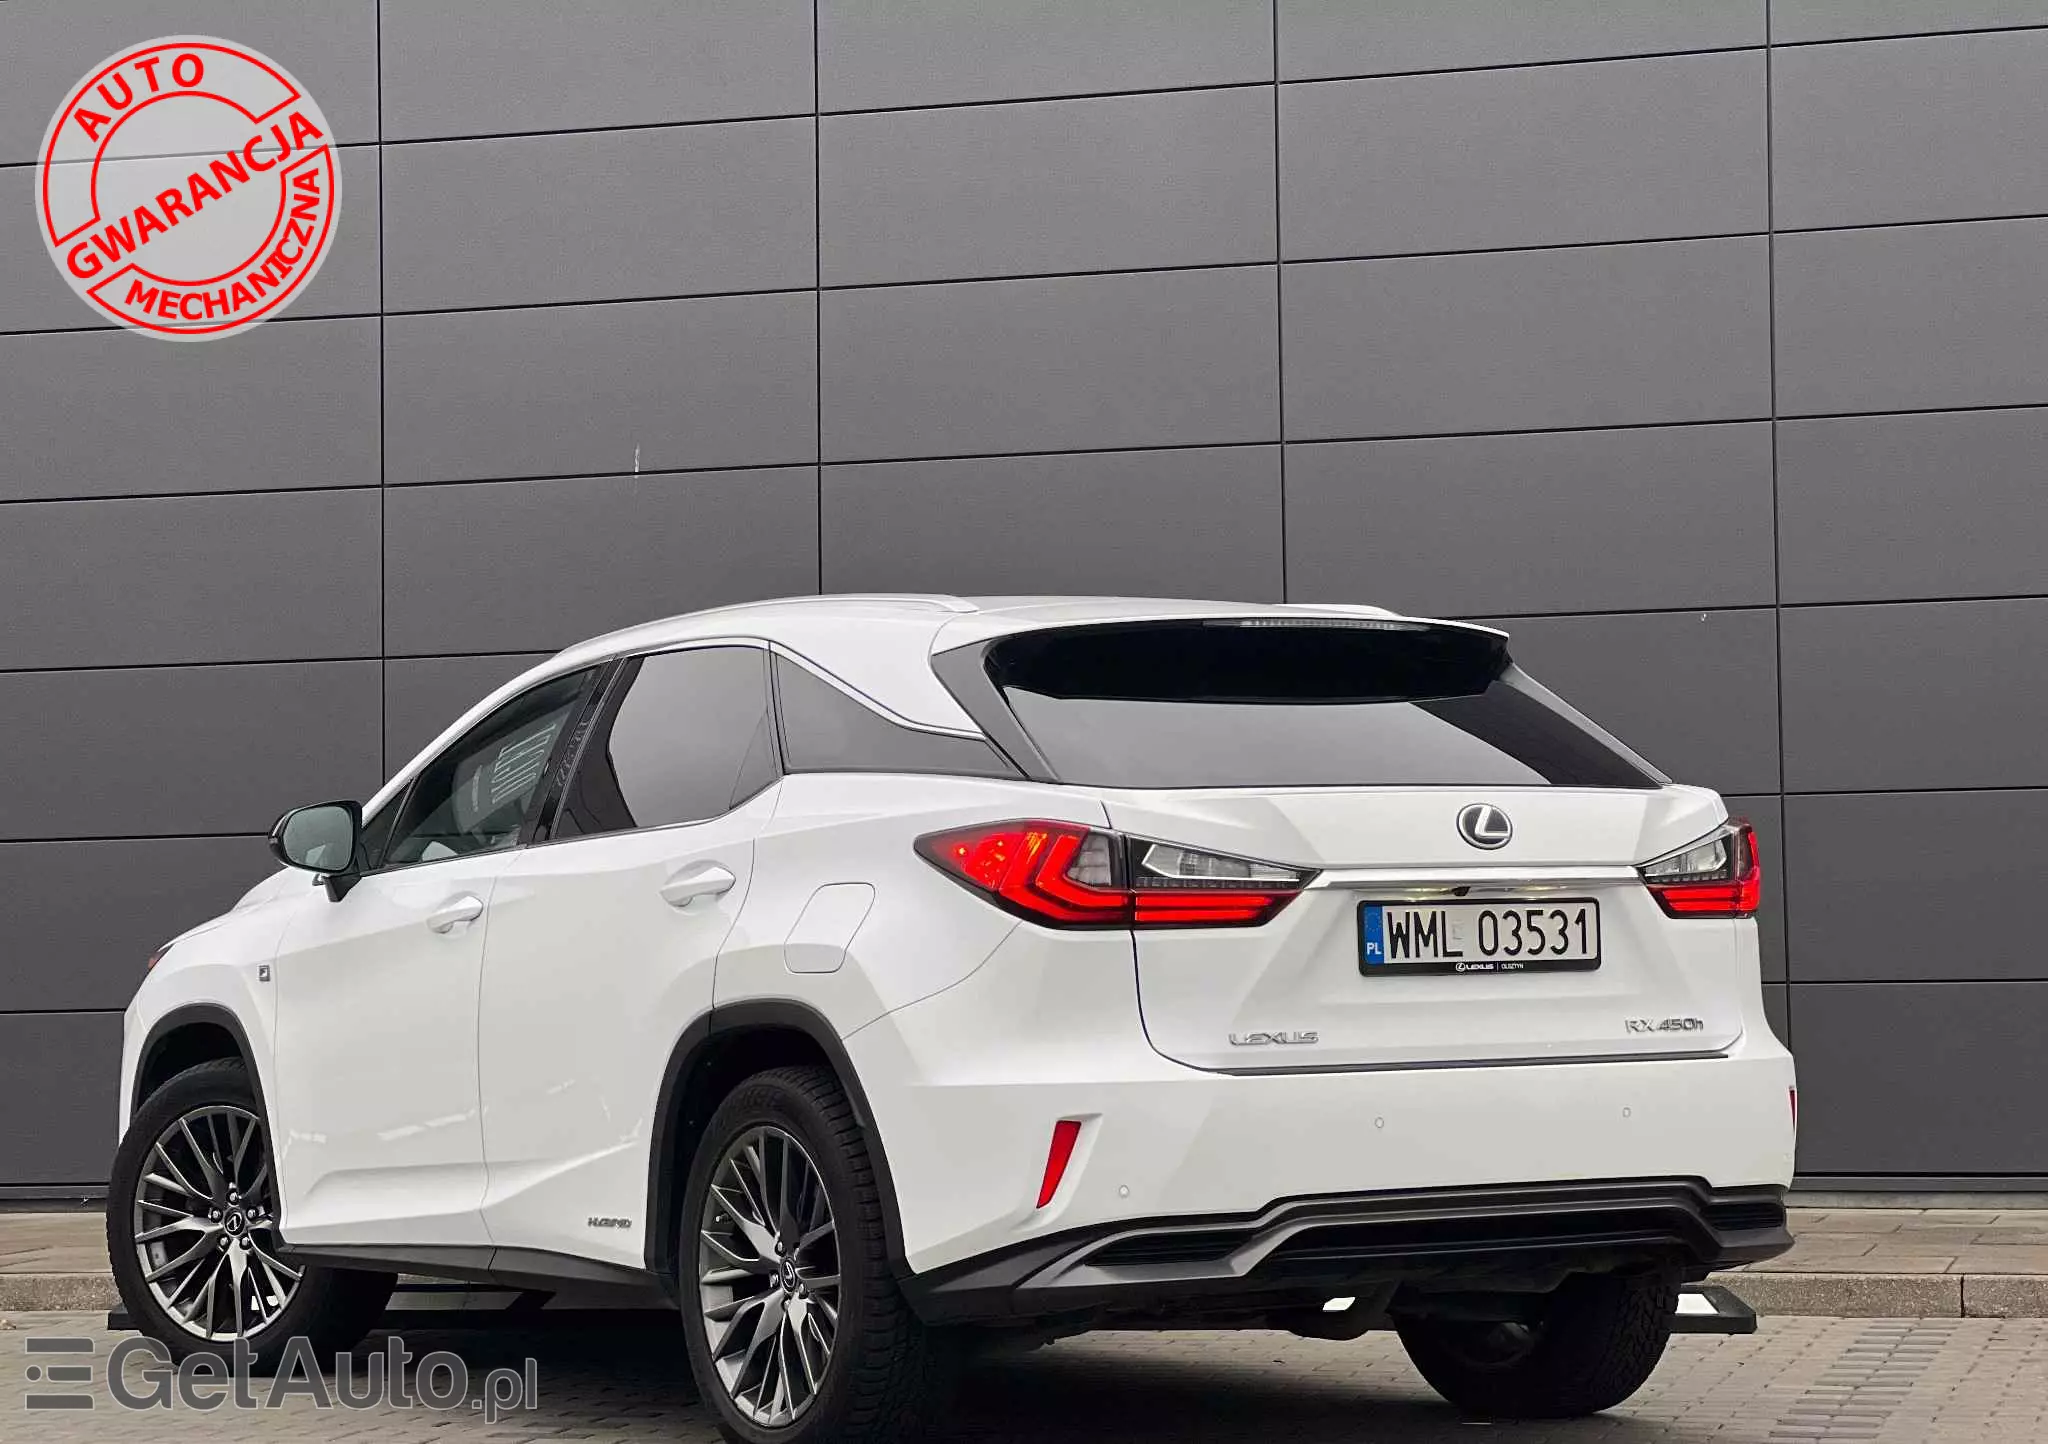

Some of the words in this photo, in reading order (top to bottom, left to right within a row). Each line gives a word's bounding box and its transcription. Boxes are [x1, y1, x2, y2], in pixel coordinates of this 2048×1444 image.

[1387, 910, 1463, 958] WML
[1478, 908, 1588, 957] 03531
[1366, 942, 1382, 955] PL
[1624, 1018, 1655, 1034] RX
[1656, 1017, 1704, 1032] 450h
[1228, 1031, 1319, 1046] LEXUS
